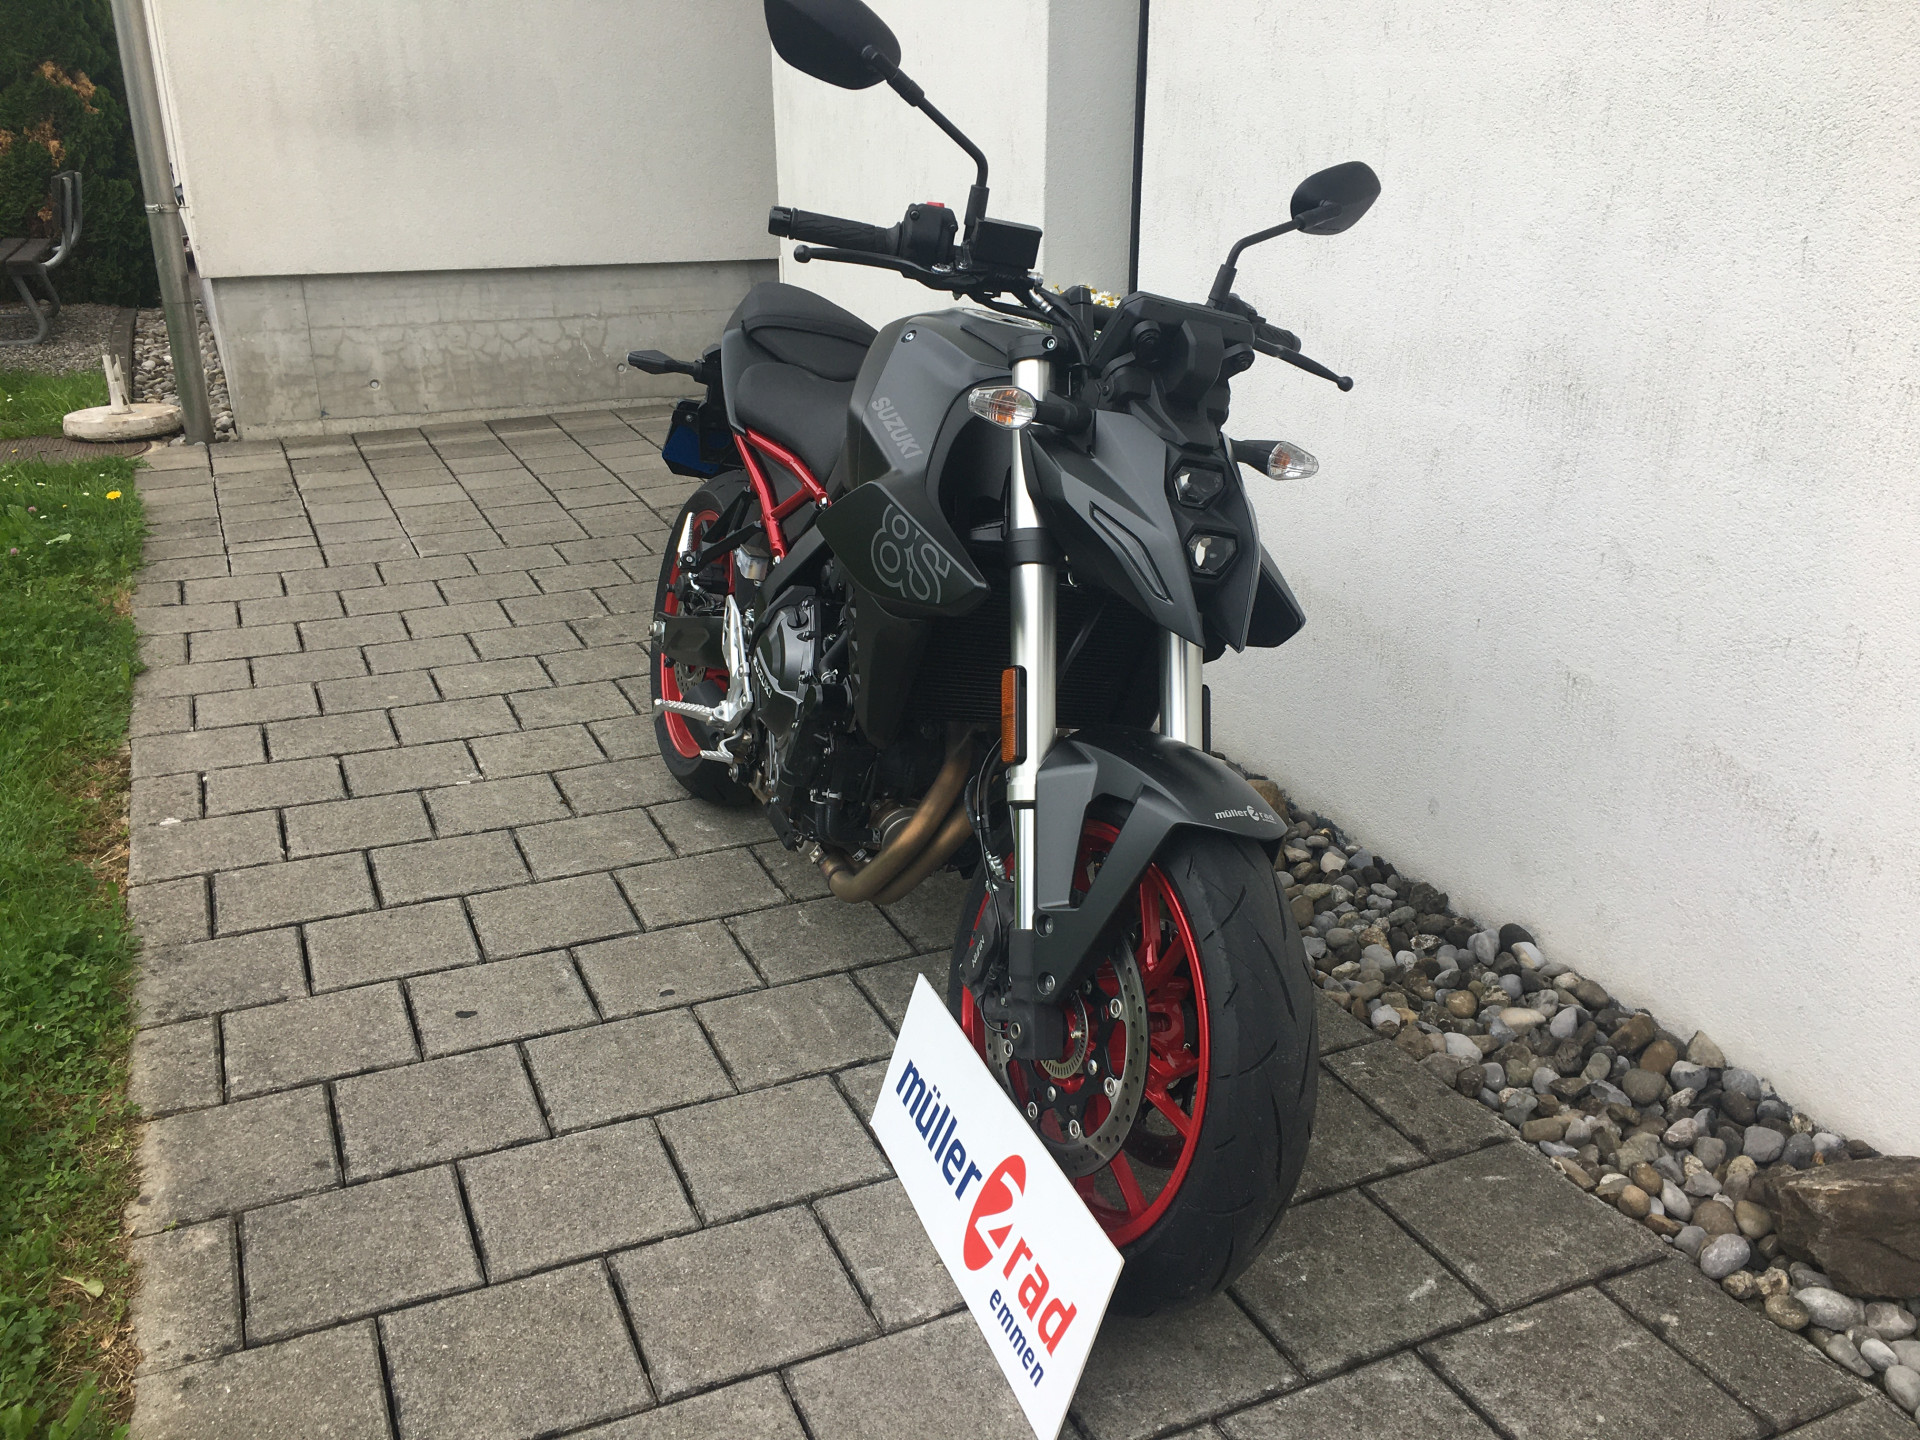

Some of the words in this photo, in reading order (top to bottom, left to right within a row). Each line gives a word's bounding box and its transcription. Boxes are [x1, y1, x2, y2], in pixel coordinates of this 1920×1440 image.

[871, 396, 923, 460] SUZUKI
[896, 1059, 982, 1201] müller
[989, 1289, 1044, 1388] emmen
